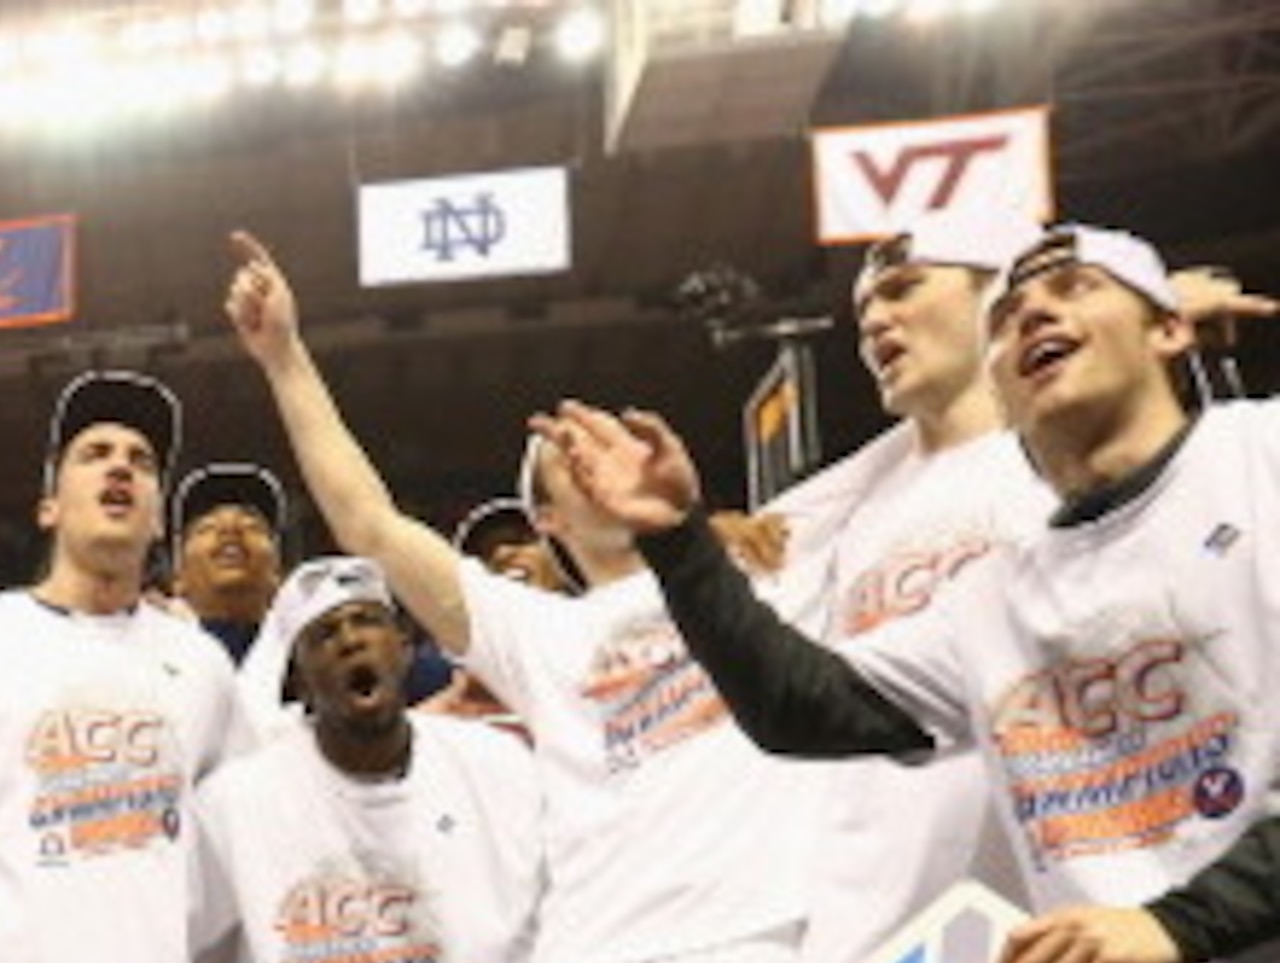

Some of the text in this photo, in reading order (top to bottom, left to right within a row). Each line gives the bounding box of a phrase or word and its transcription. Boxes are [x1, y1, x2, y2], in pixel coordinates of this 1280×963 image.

[848, 133, 1010, 213] VT
[996, 639, 1185, 740] ACC
[25, 709, 164, 768] ACC
